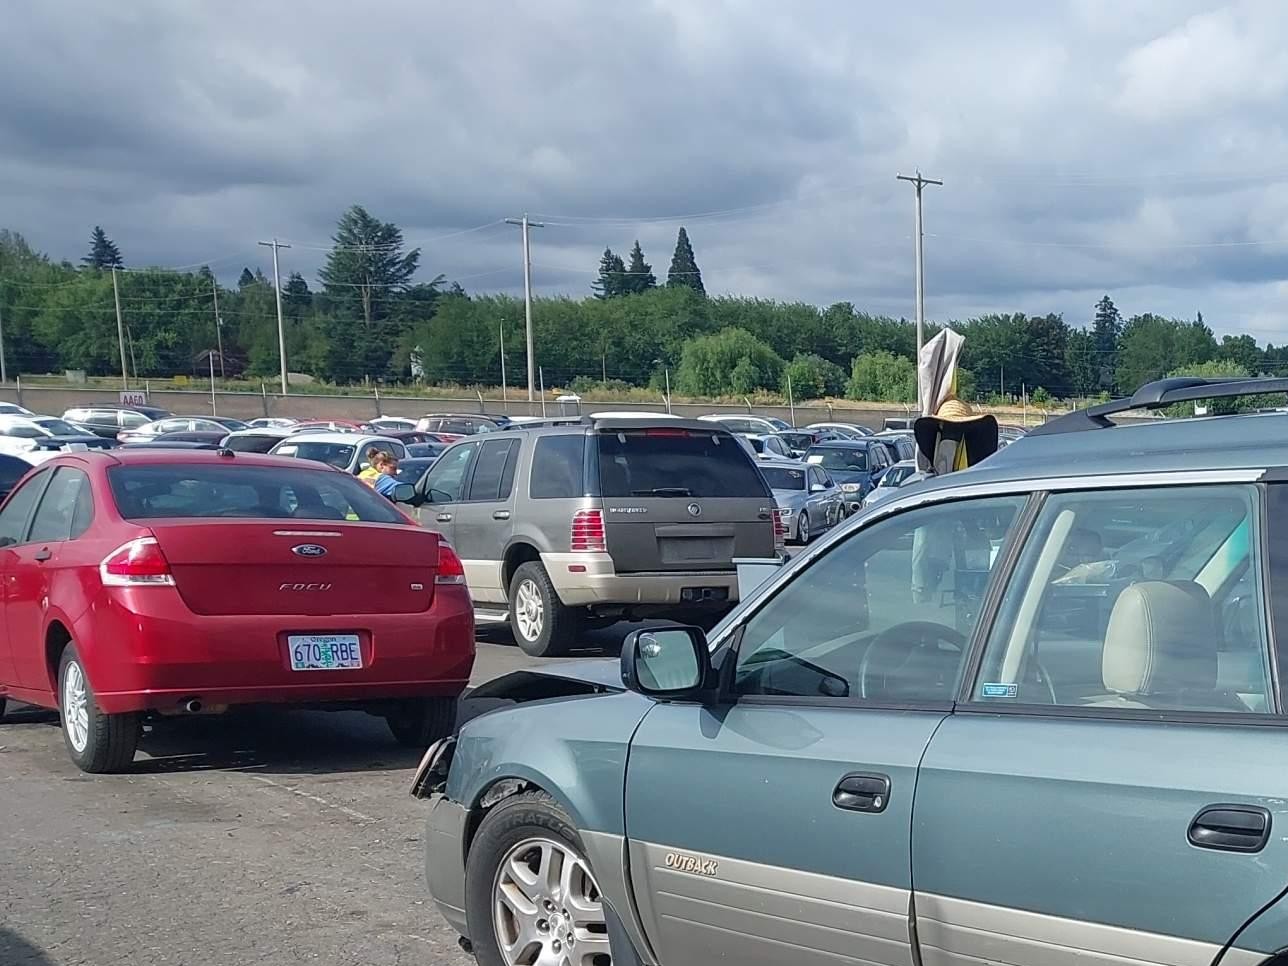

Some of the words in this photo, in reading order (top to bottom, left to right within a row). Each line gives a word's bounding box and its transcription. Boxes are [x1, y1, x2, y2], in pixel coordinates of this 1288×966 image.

[279, 583, 332, 591] FOCU
[294, 644, 322, 662] 670
[330, 642, 359, 661] RBE
[665, 852, 719, 876] OUTBACK
